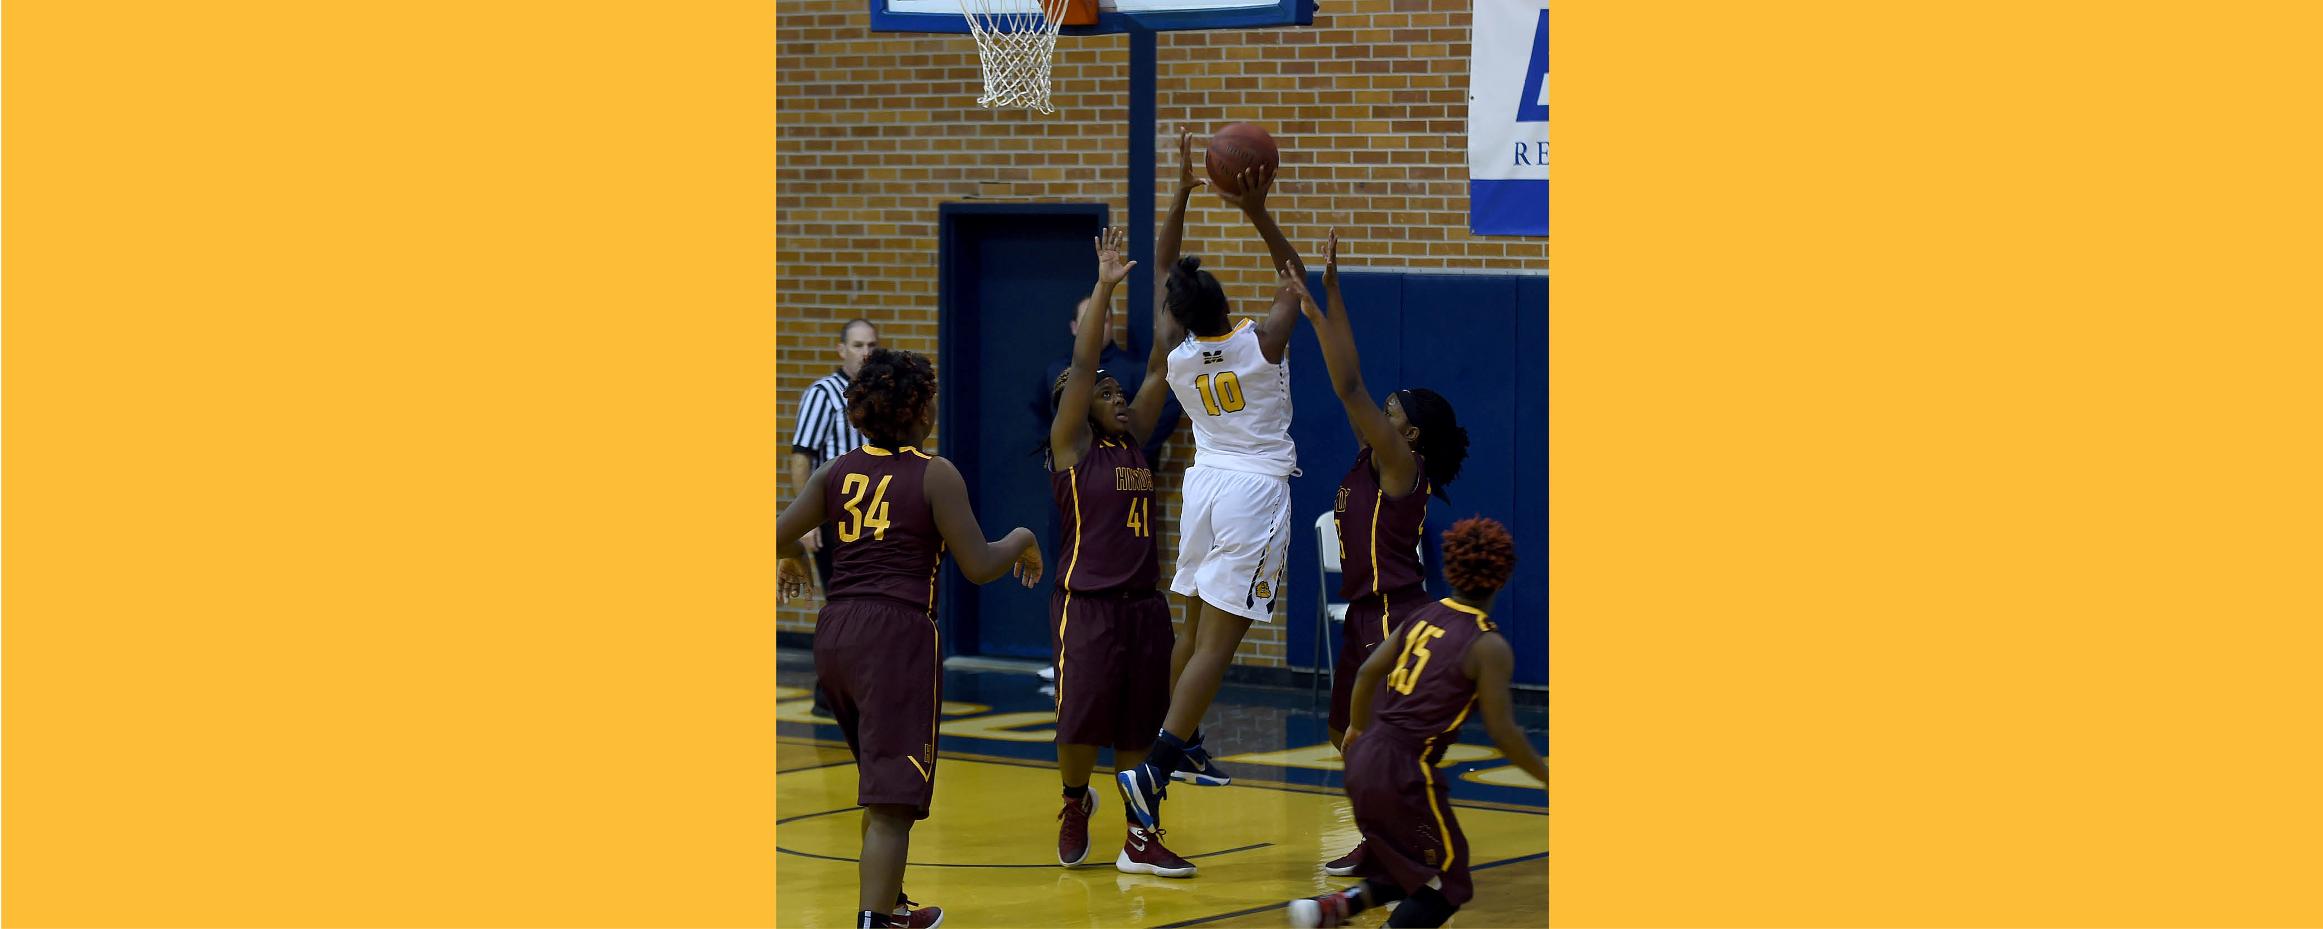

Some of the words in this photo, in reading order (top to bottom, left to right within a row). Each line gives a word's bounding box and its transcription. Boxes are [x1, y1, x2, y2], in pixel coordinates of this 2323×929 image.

[1195, 371, 1246, 416] 10
[838, 473, 893, 543] 34
[1126, 497, 1149, 537] 41
